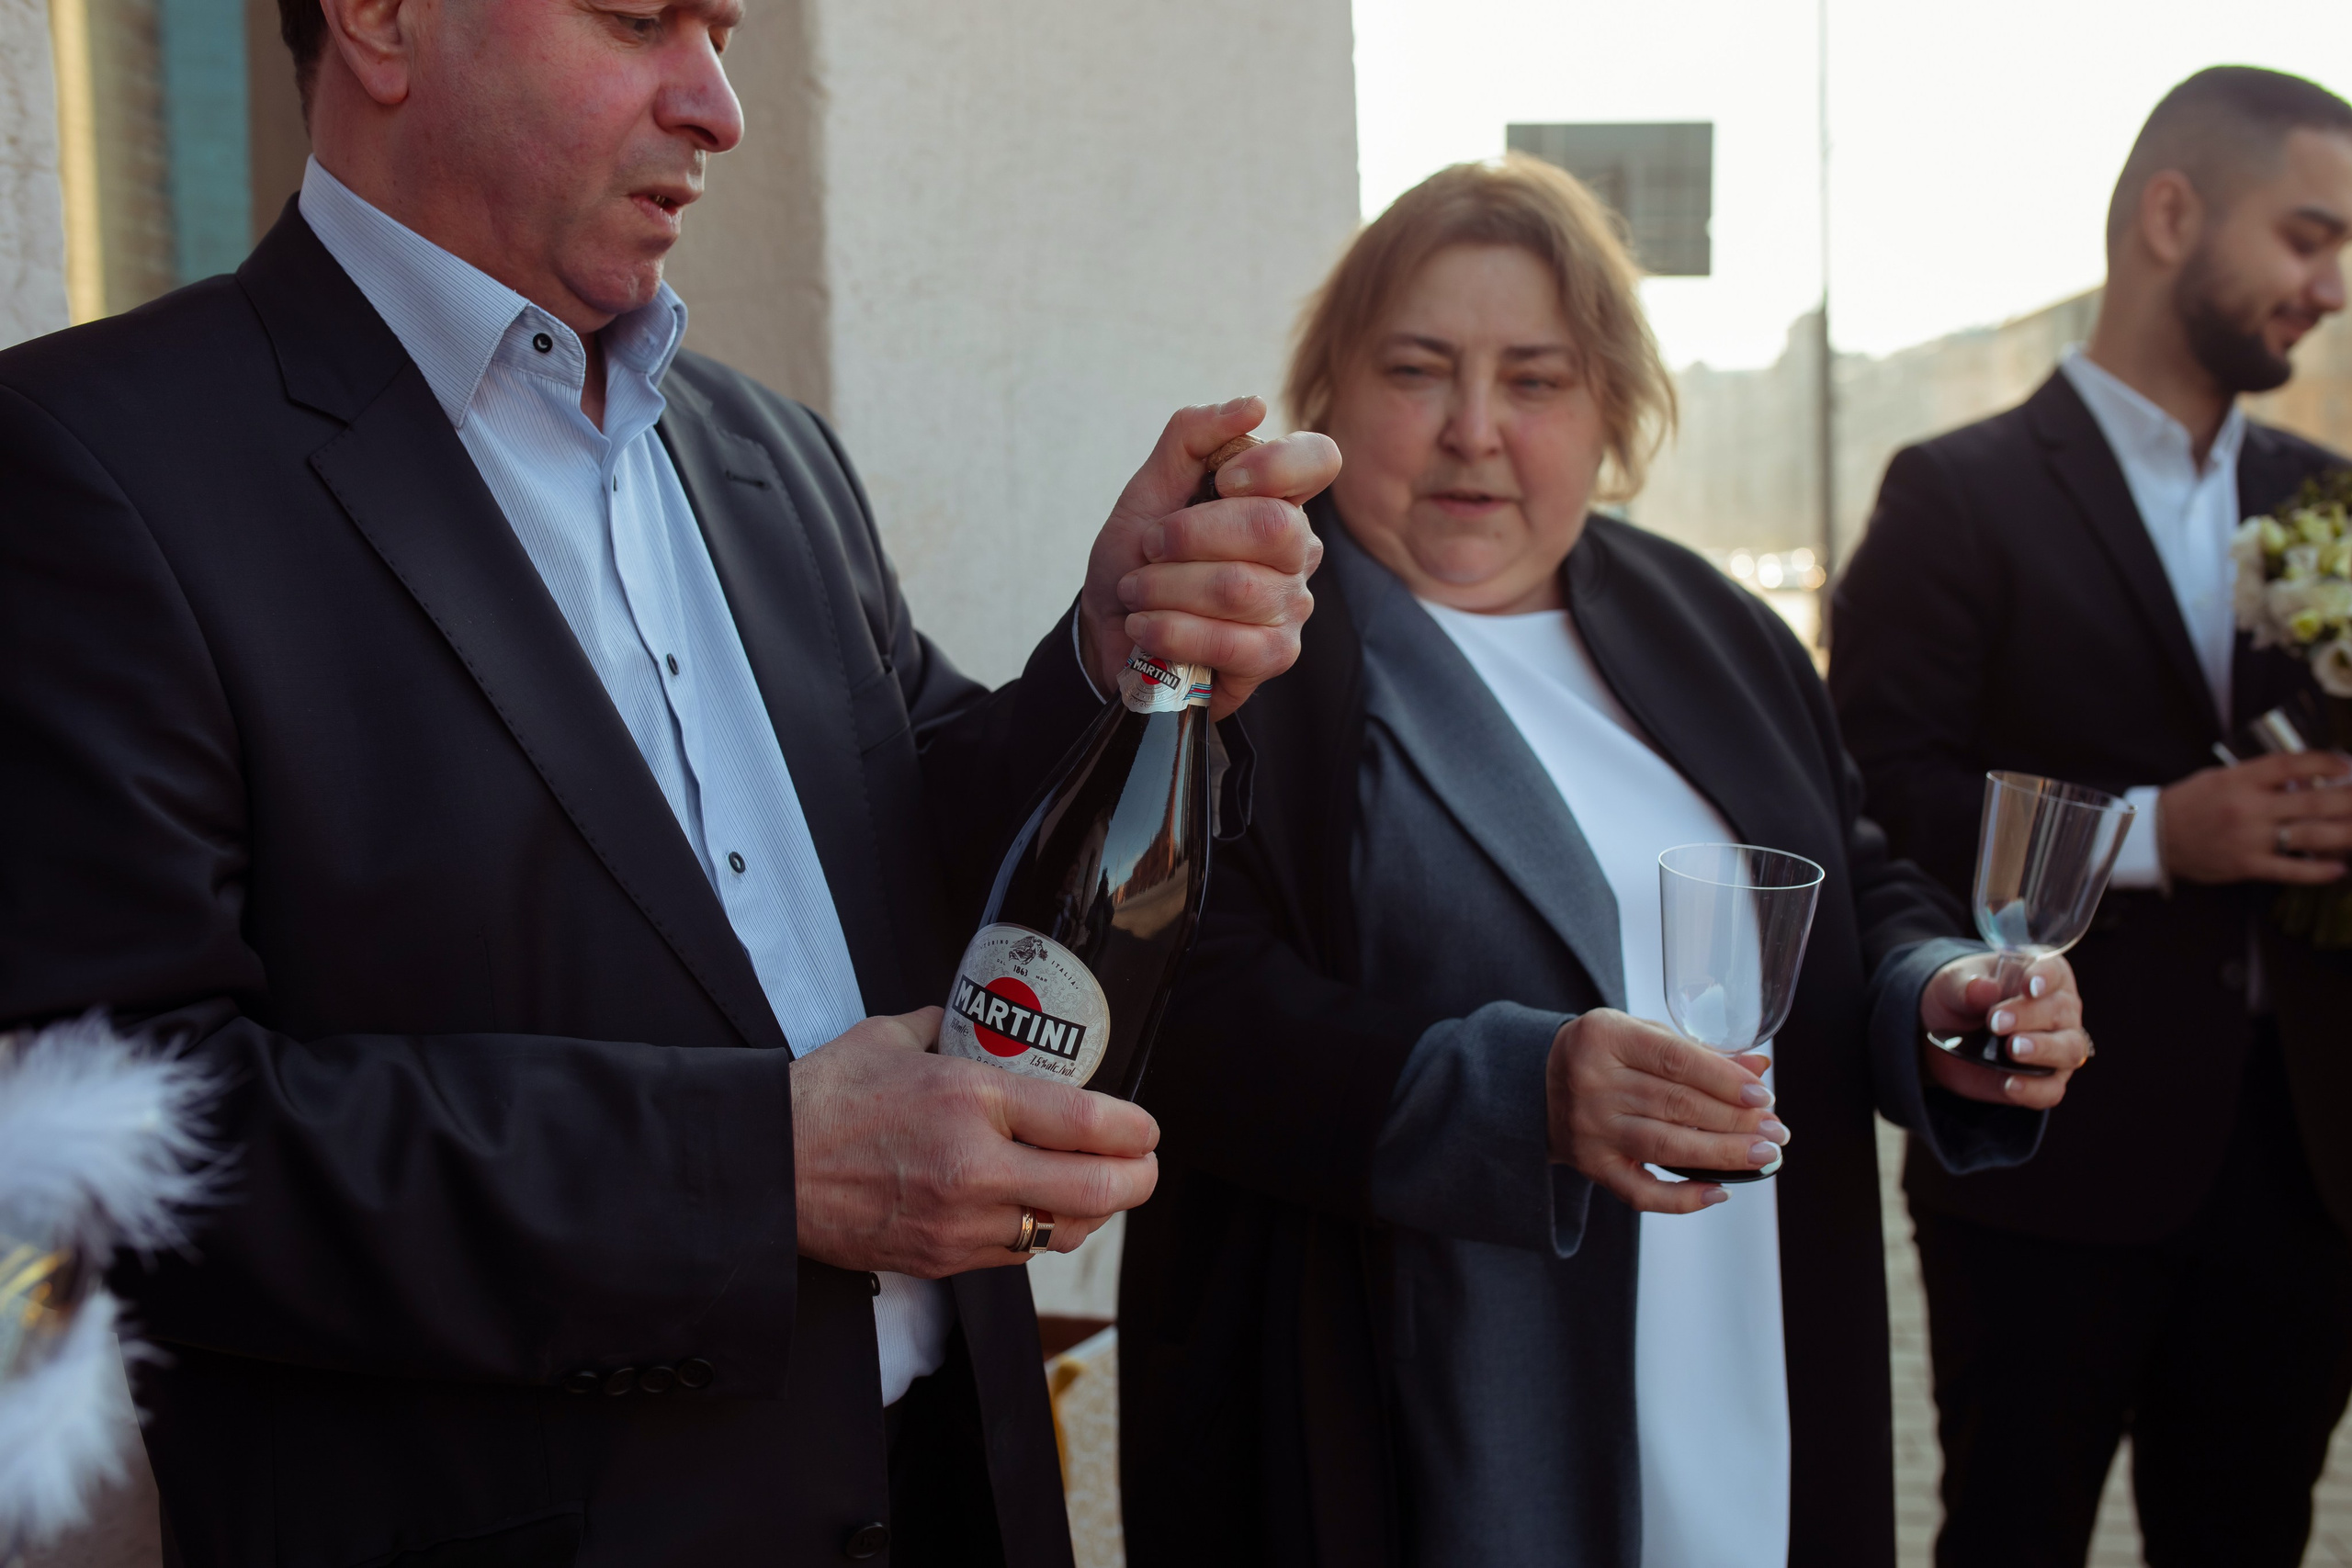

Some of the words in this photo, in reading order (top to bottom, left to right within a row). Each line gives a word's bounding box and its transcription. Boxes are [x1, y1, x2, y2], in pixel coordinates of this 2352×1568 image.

[1133, 659, 1178, 687] MARTINI
[983, 940, 1009, 948] TORINO
[1051, 960, 1076, 986] ITALIA
[1013, 964, 1028, 976] 1863
[955, 979, 1079, 1055] MARTINI
